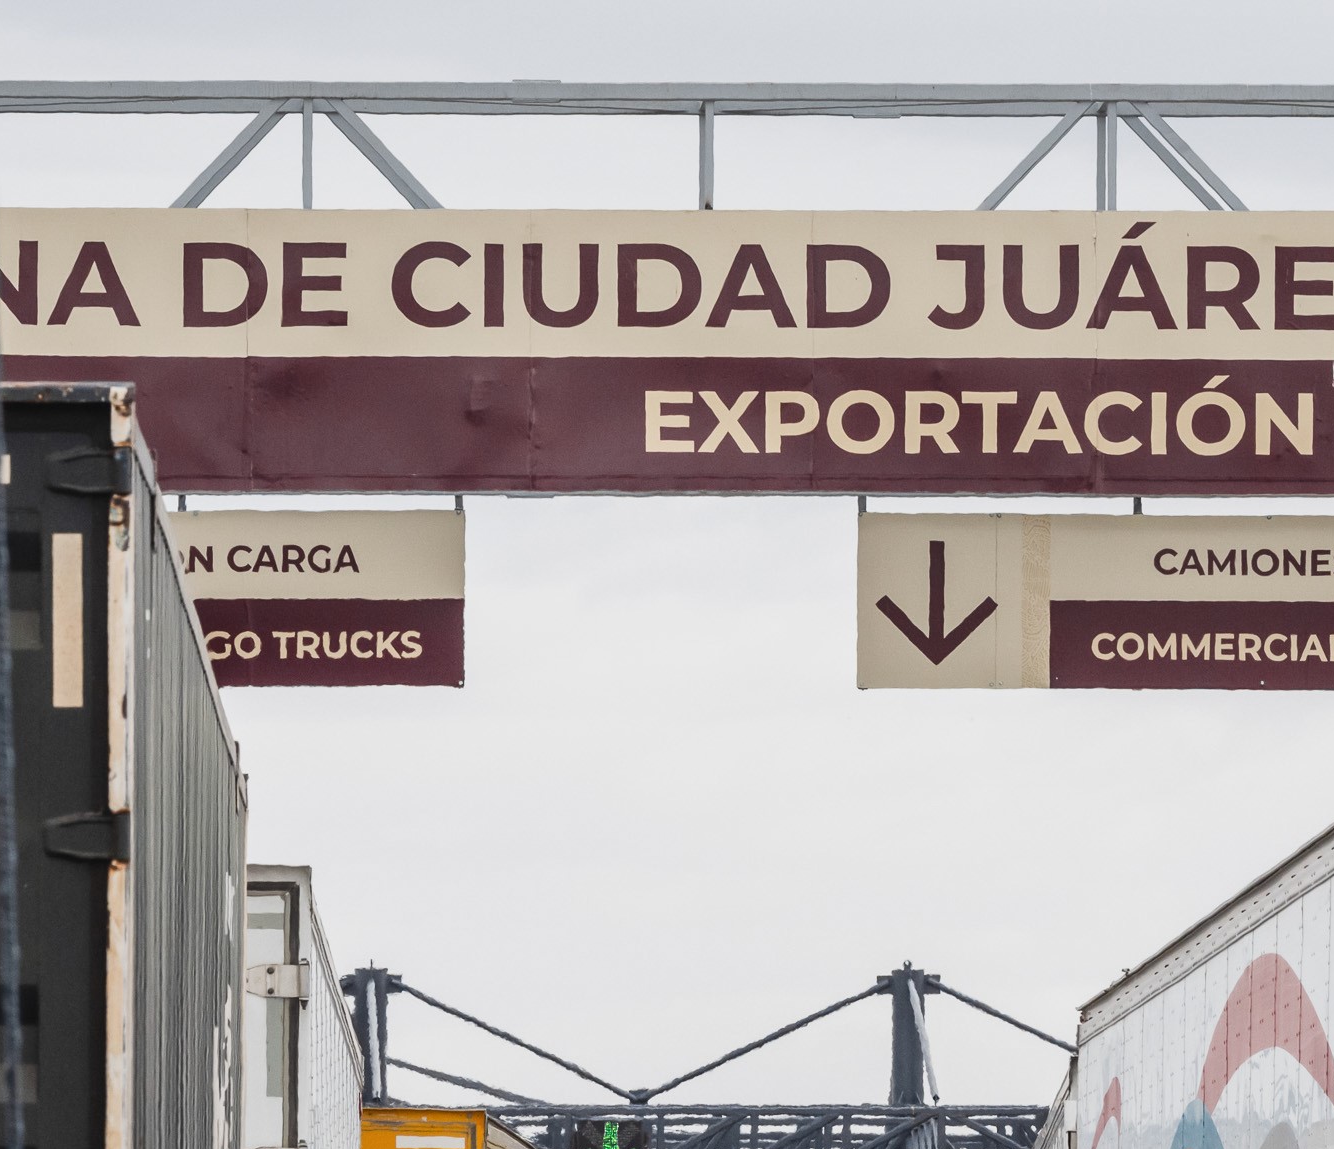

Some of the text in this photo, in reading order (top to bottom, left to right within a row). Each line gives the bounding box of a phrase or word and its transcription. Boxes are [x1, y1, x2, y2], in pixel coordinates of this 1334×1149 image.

[183, 242, 348, 327] DE
[392, 241, 890, 328] CIUDAD
[645, 375, 1313, 456] EXPORTACIÓN
[227, 544, 360, 573] CARGA
[272, 630, 423, 660] TRUCKS
